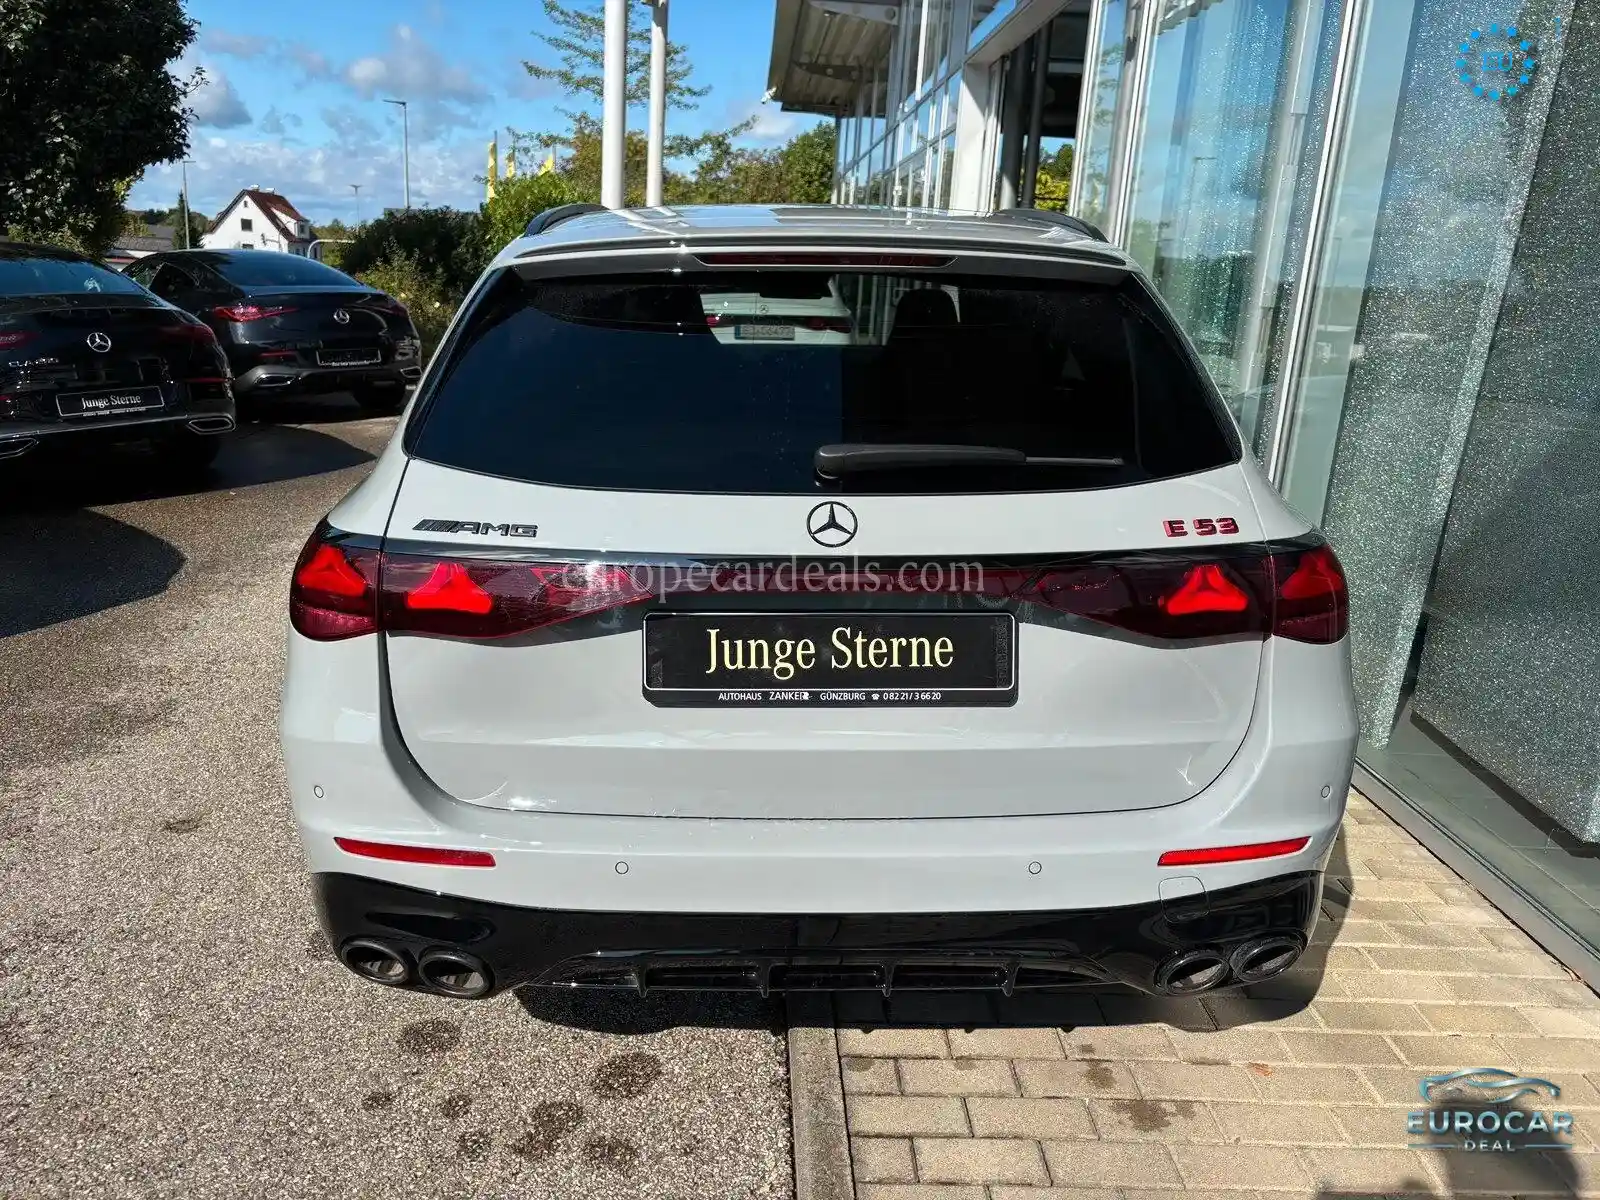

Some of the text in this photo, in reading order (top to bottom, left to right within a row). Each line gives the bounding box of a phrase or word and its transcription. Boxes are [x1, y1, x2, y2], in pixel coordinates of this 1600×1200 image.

[81, 394, 141, 409] Junge Sterne
[448, 520, 538, 537] AMG
[1163, 517, 1239, 537] E 53
[705, 626, 954, 680] Junge Sterne
[718, 692, 762, 701] AUTOHAUS
[820, 690, 866, 700] GÜNZBURG
